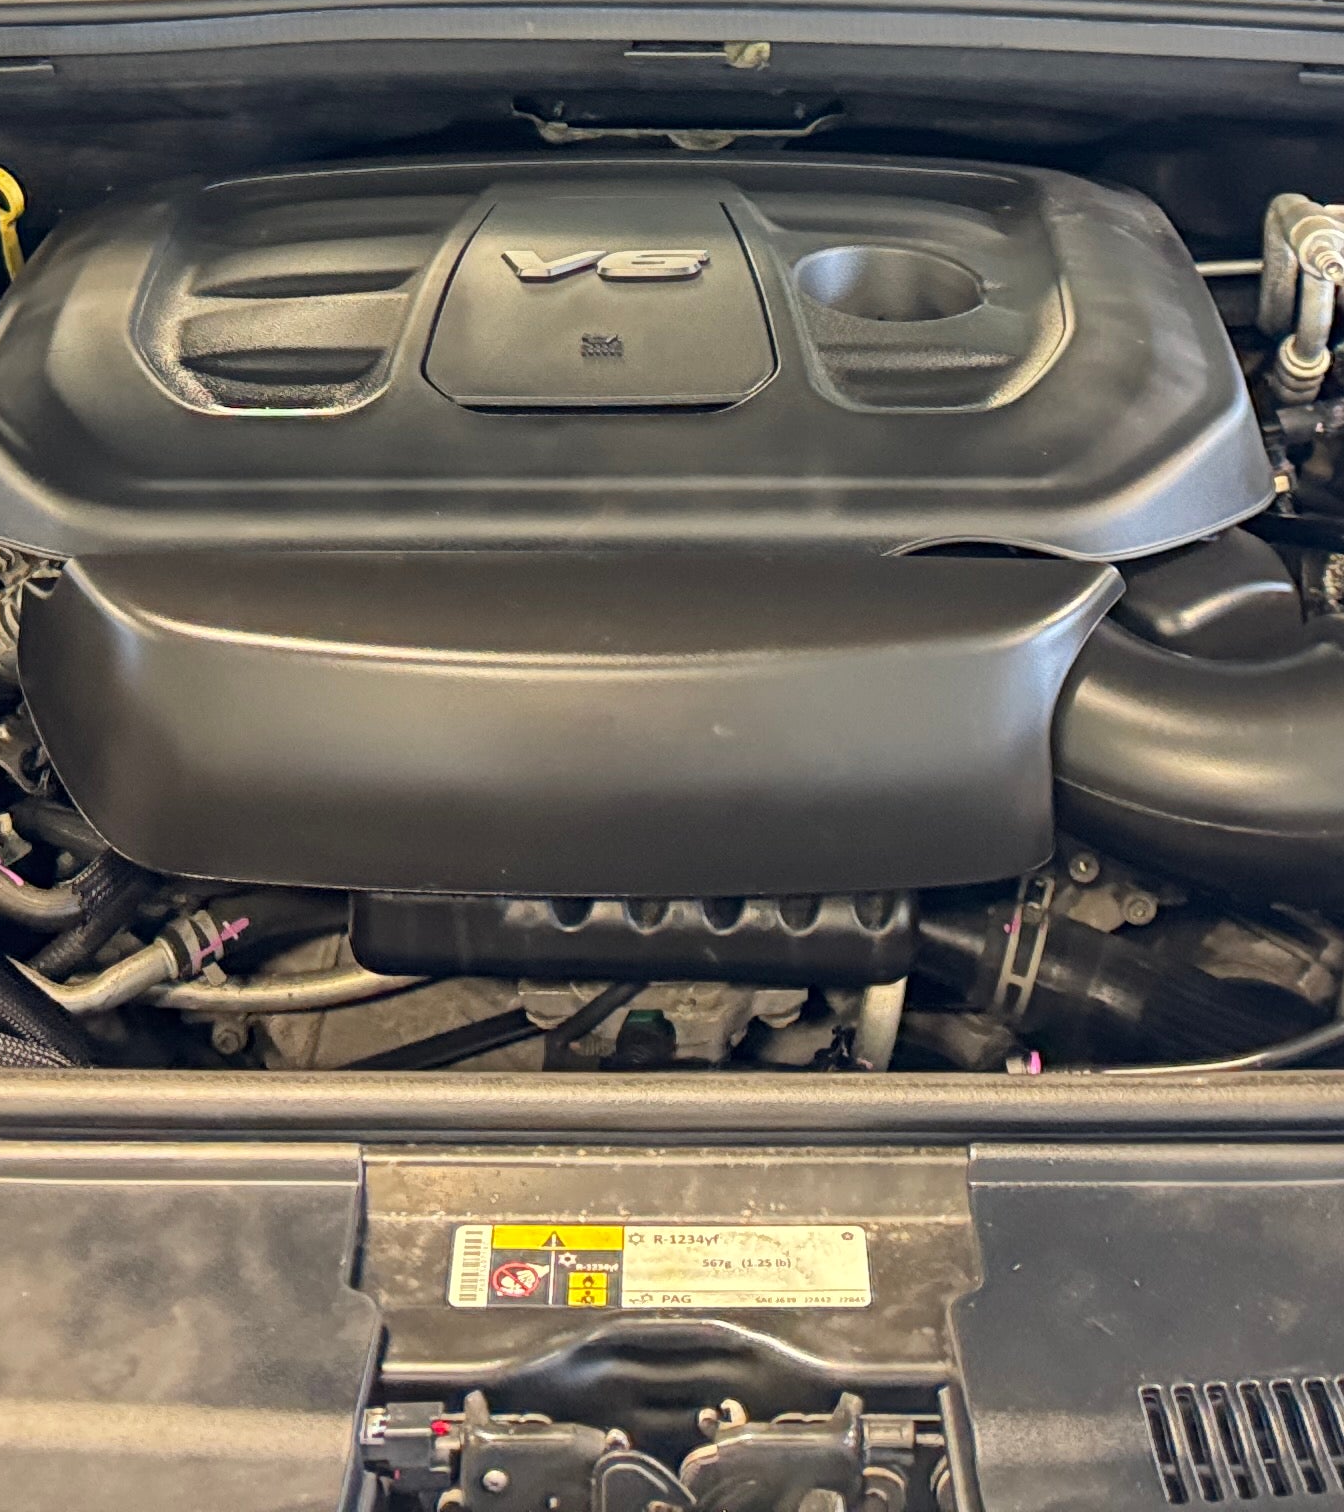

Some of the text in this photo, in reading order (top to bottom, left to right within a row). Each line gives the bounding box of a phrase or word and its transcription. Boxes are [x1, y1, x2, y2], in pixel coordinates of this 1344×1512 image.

[501, 249, 709, 284] V6
[653, 1234, 719, 1246] R-1234yf
[702, 1259, 732, 1269] 567g
[661, 1294, 692, 1303] PAG
